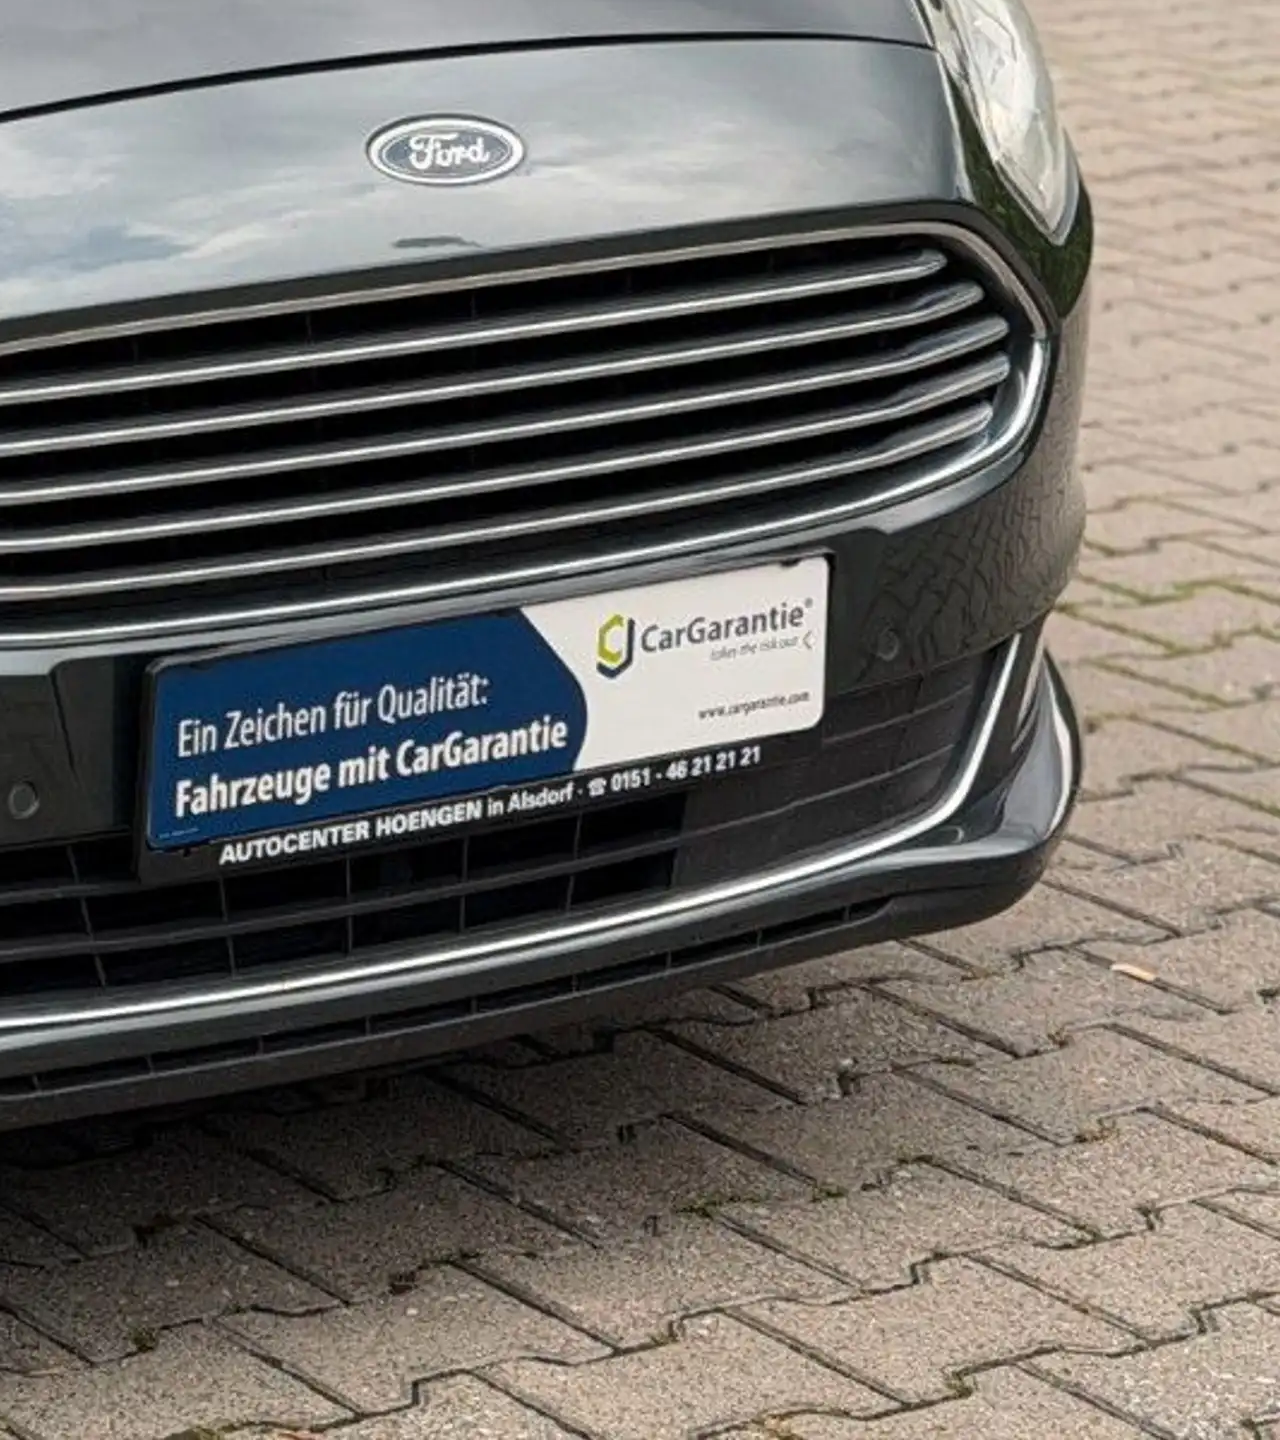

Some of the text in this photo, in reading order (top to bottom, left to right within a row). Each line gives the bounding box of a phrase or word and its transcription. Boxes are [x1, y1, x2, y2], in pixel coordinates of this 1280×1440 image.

[409, 132, 491, 170] Ford
[739, 641, 758, 656] the
[759, 637, 777, 652] risk
[779, 634, 799, 649] out
[178, 672, 489, 757] Ein Zeichen für Qualität:
[698, 690, 811, 720] www.cargarantie.com
[176, 715, 568, 818] Fahrzeuge mit CarGarantie
[219, 820, 369, 865] AUTOCENTER
[376, 799, 482, 837] HOENGEN
[487, 797, 504, 817] in
[507, 781, 575, 814] Alsdorf
[610, 767, 651, 792] 0151
[665, 760, 688, 781] 46
[692, 755, 713, 777] 21
[716, 750, 737, 772] 21
[740, 745, 762, 766] 21
